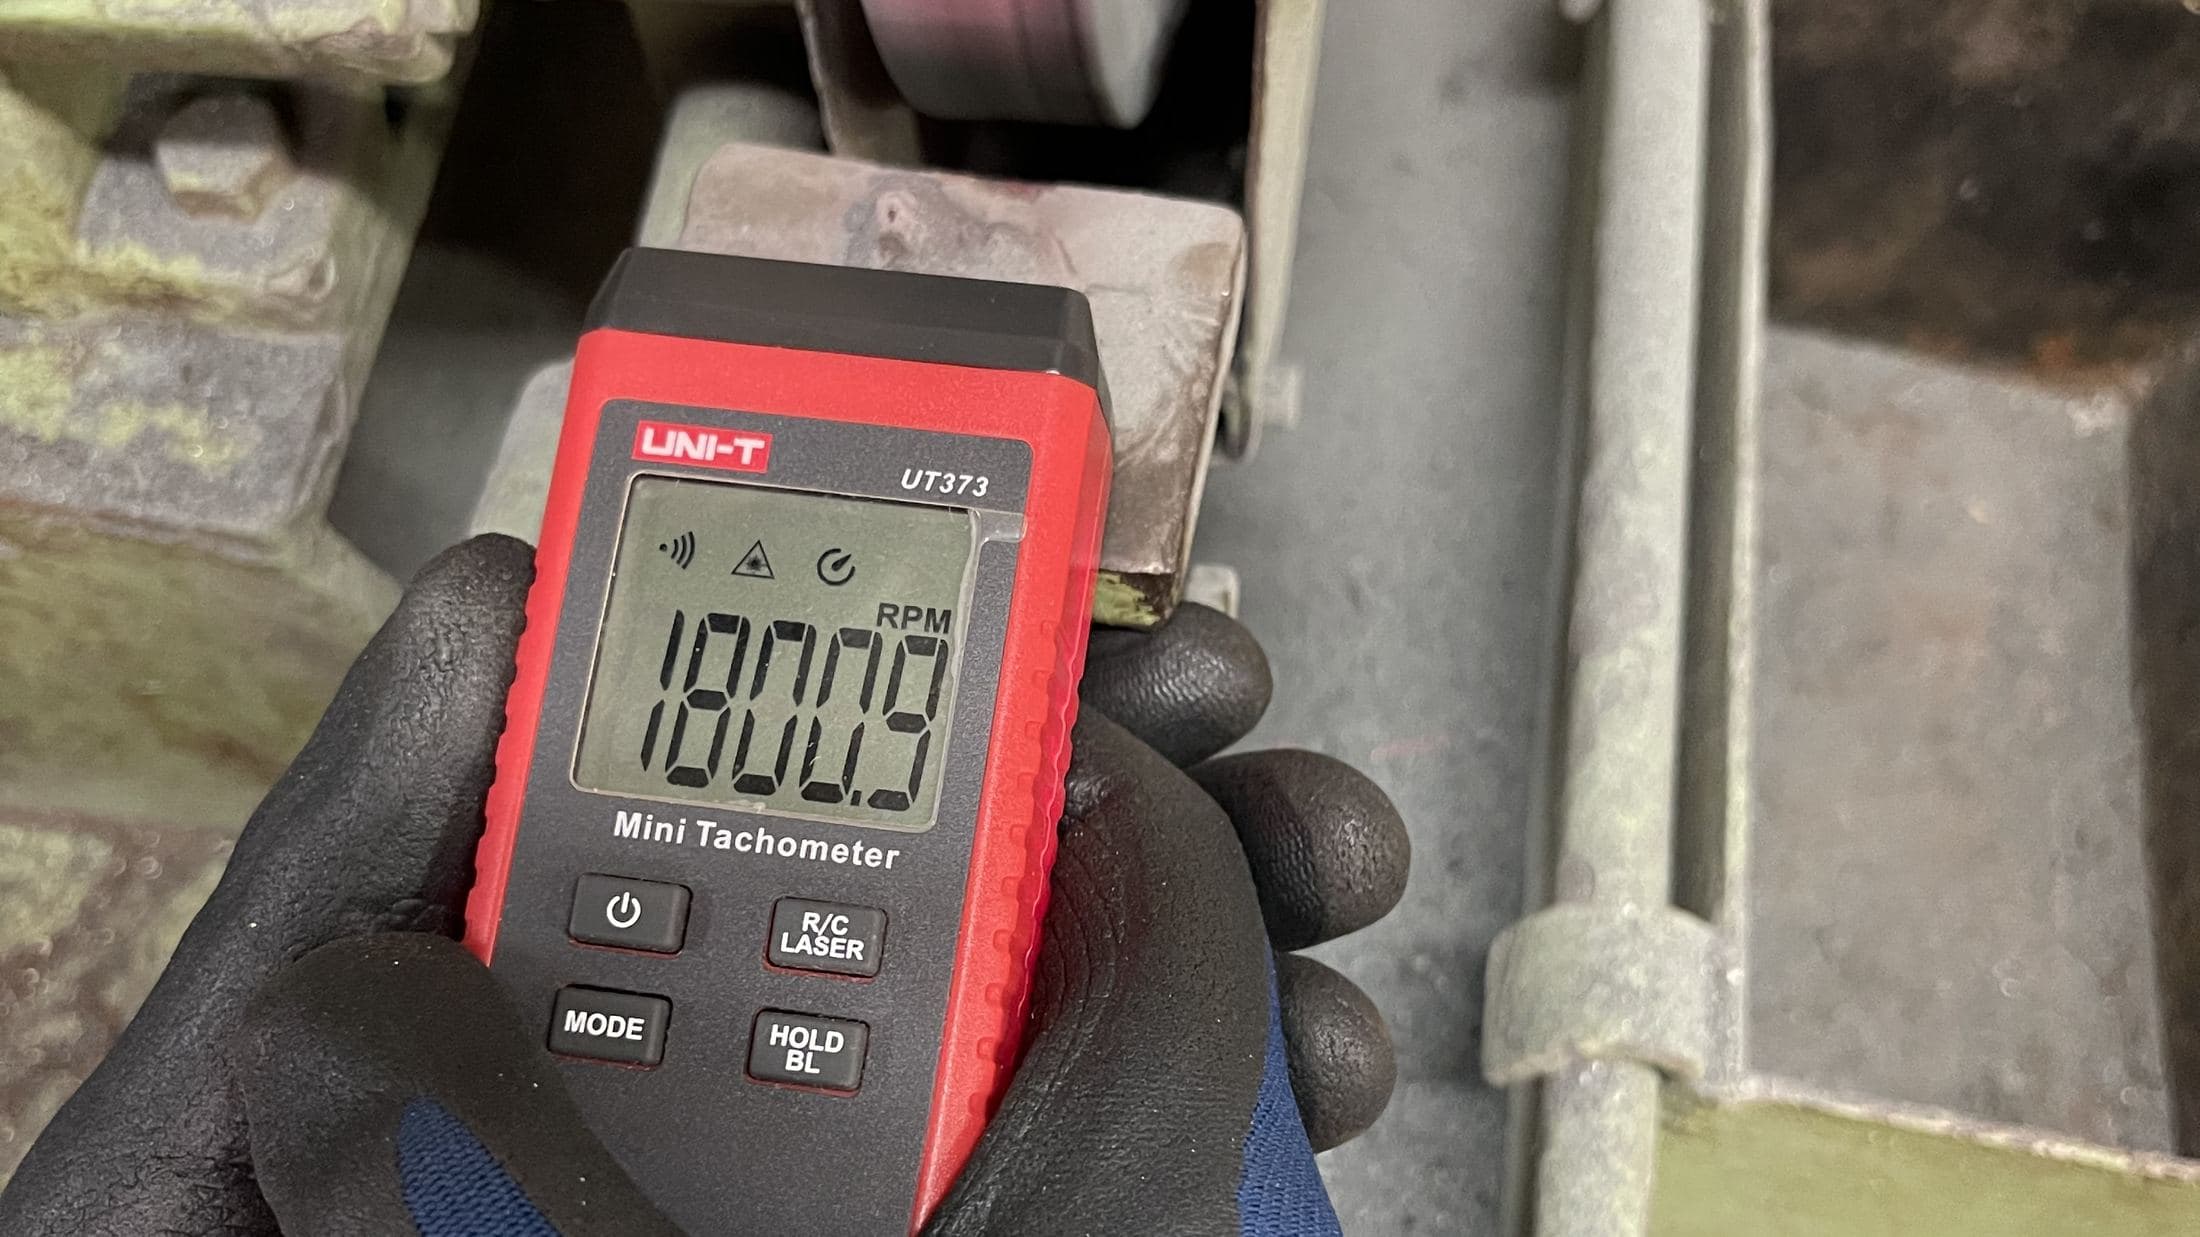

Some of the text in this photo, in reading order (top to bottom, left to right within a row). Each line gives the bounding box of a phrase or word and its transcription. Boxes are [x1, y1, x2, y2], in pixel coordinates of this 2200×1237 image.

[641, 428, 765, 465] UNI-T
[901, 468, 989, 497] UT373
[876, 602, 952, 634] RPM
[640, 609, 949, 811] 1800.9
[613, 810, 900, 869] Mini Tachometer
[802, 911, 849, 937] R/C
[780, 932, 865, 960] LASER
[564, 1010, 645, 1041] MODE
[769, 1024, 844, 1053] HOLD
[785, 1050, 820, 1074] BL
